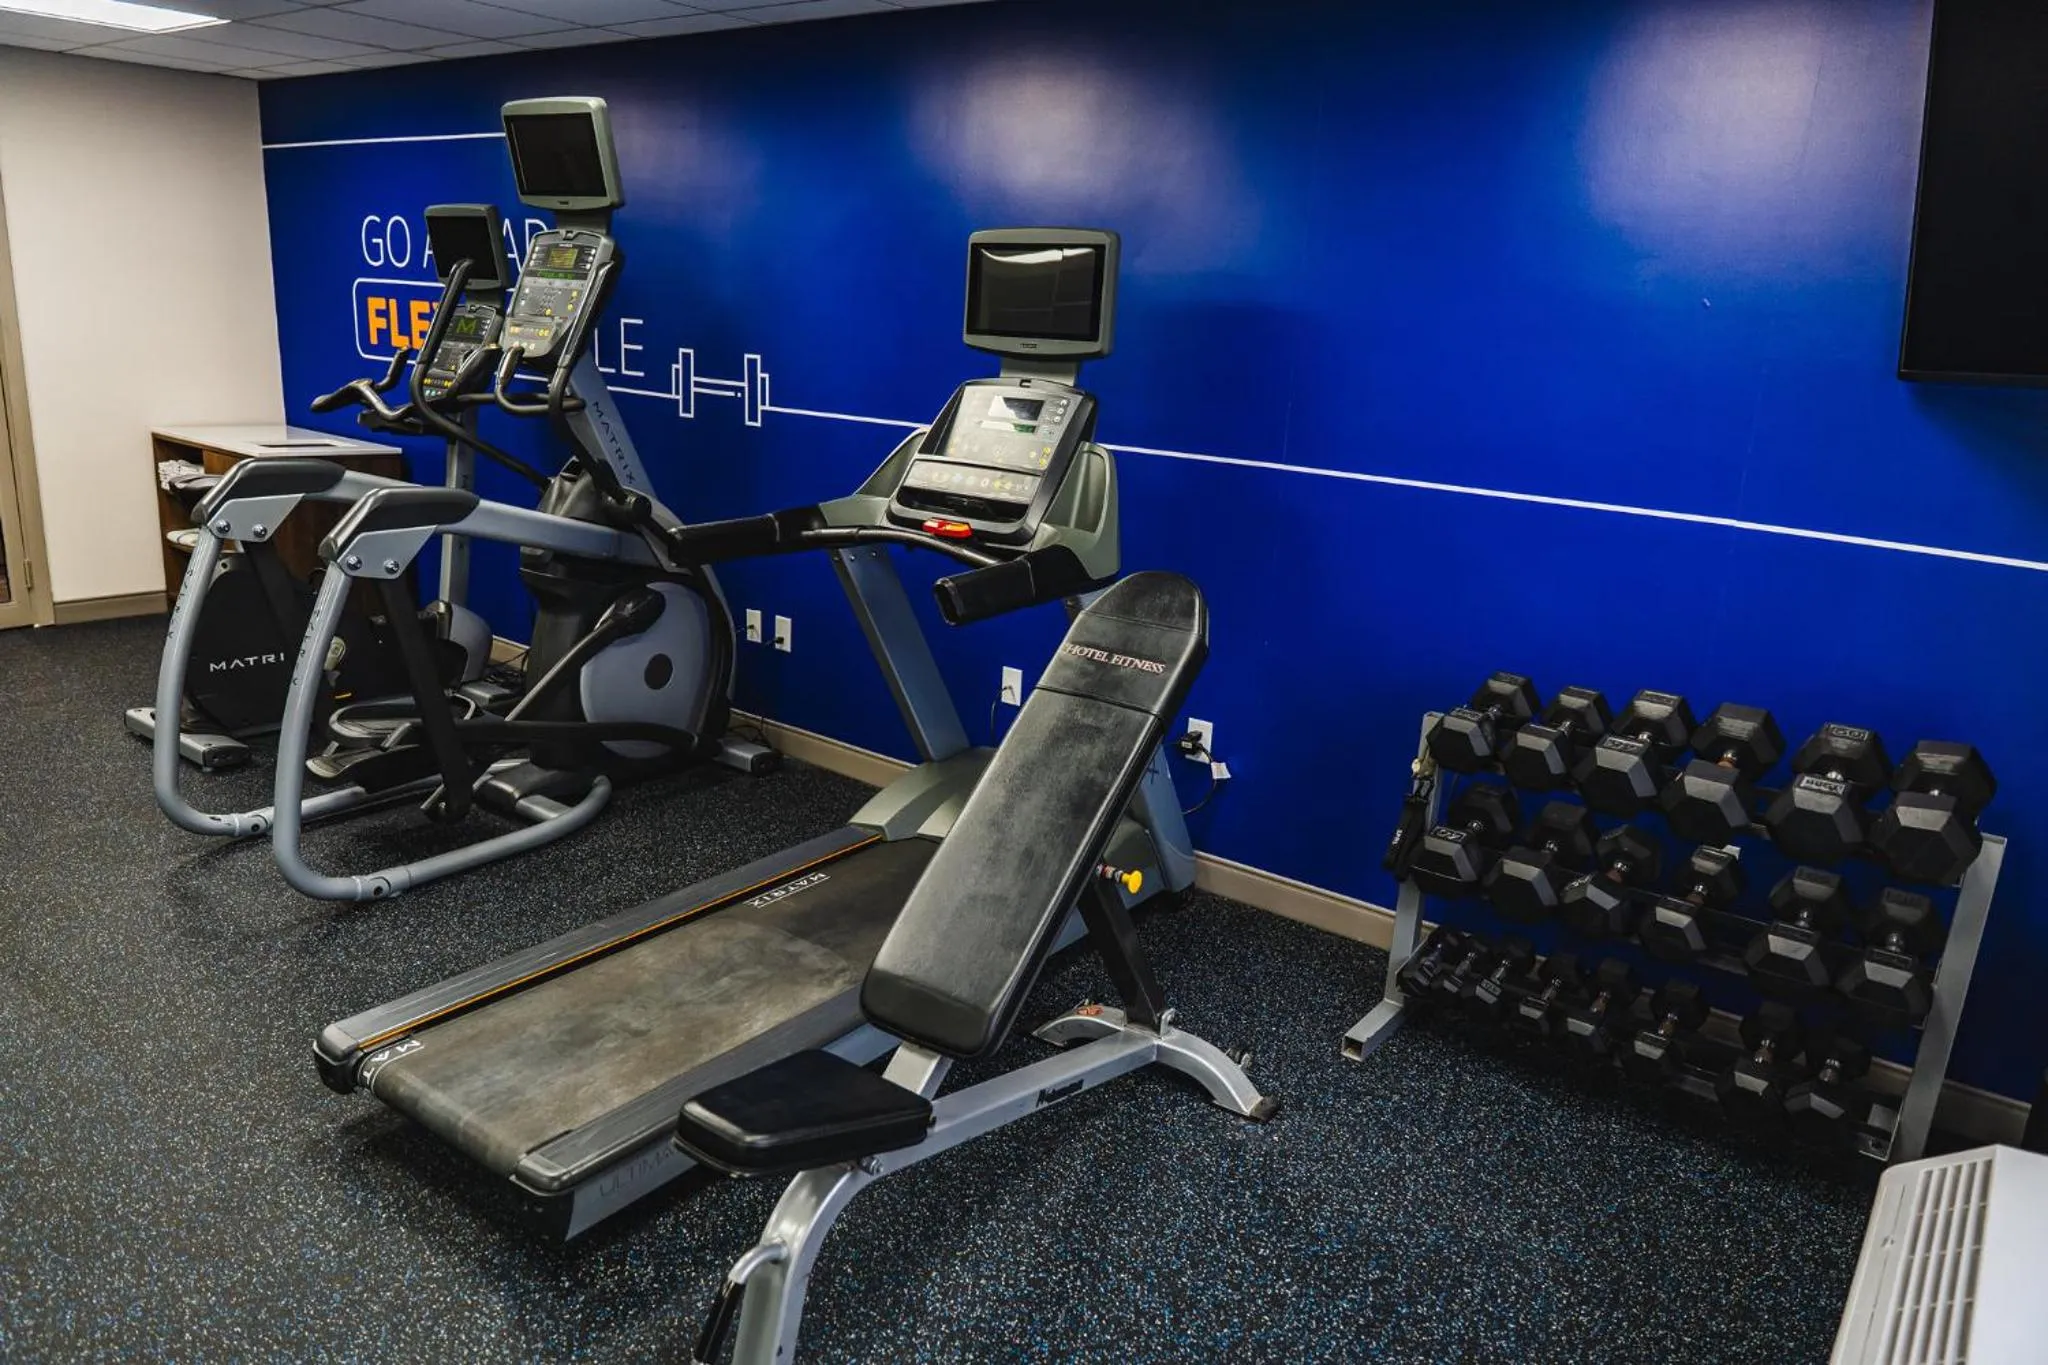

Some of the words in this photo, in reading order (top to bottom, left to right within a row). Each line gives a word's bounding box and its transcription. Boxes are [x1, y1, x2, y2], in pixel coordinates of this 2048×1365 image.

[361, 215, 411, 268] GO
[367, 296, 440, 350] FLE
[592, 401, 637, 485] MATRIX
[209, 652, 285, 673] MATRI
[1063, 643, 1110, 664] HOTEL
[1110, 652, 1167, 674] FITNESS
[749, 871, 828, 907] MATRIX
[362, 1039, 422, 1086] MAT
